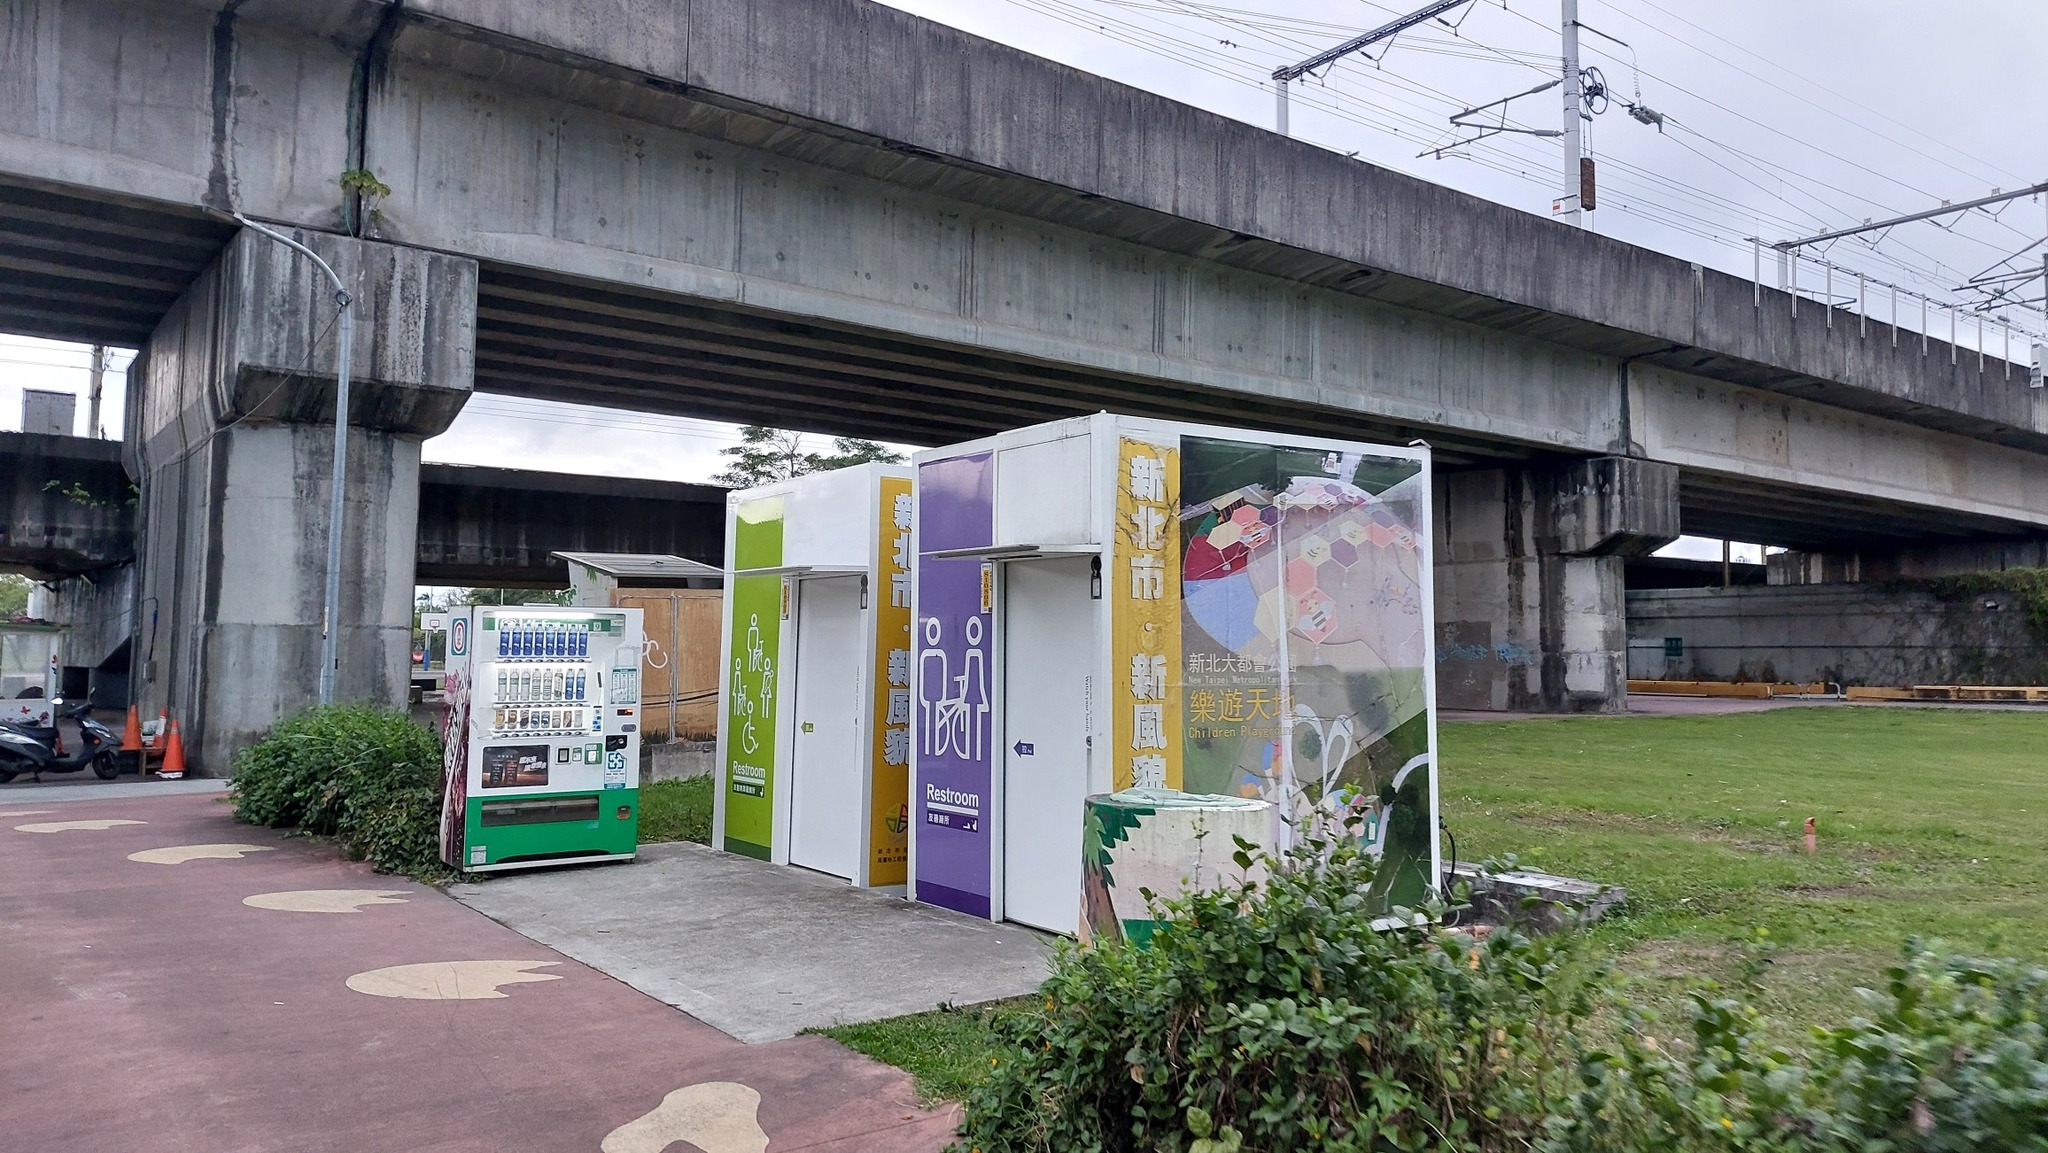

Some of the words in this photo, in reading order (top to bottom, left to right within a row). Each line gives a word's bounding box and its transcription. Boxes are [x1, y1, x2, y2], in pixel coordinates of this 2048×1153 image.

[1189, 675, 1202, 684] New
[1205, 675, 1228, 685] Taipei
[1189, 727, 1236, 738] Children
[733, 760, 766, 779] Restroom
[927, 783, 979, 808] Restroom
